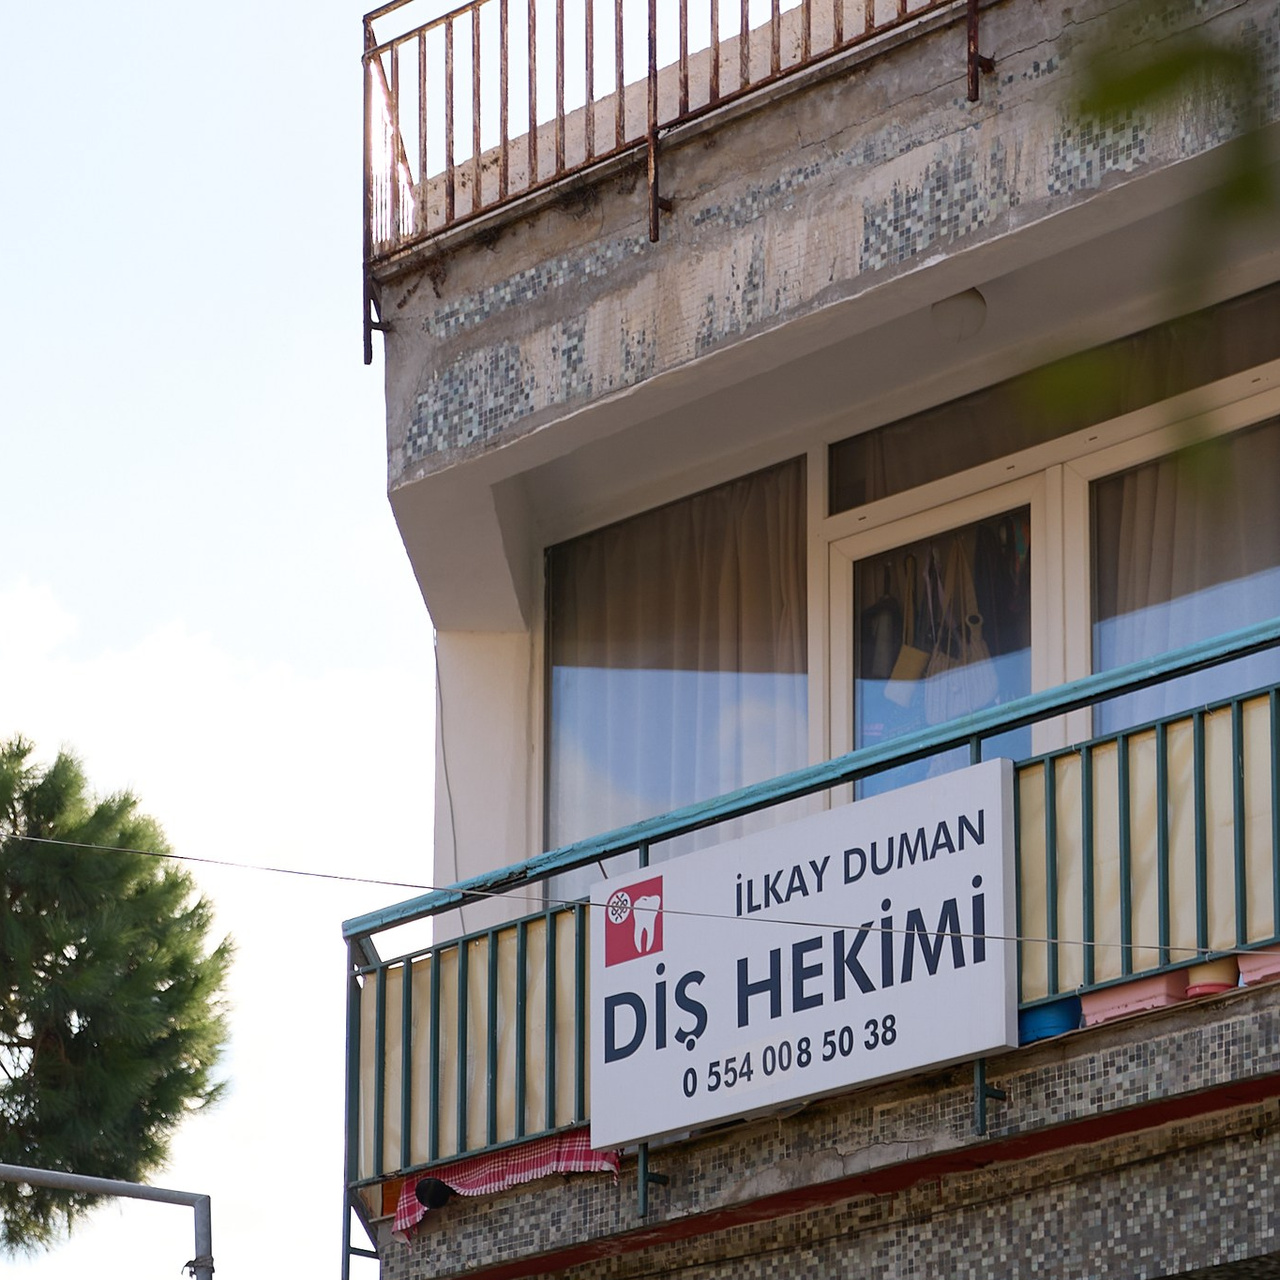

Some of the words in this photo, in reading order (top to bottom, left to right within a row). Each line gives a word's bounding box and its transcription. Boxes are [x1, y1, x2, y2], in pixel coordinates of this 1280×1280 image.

[735, 856, 831, 917] İLKAY
[843, 809, 986, 885] DUMAN
[604, 962, 709, 1064] DİŞ
[736, 874, 987, 1029] HEKİMİ
[682, 1067, 698, 1098] 0
[707, 1052, 754, 1093] 554
[762, 1037, 812, 1077] 008
[822, 1025, 854, 1062] 50
[864, 1014, 898, 1050] 38
